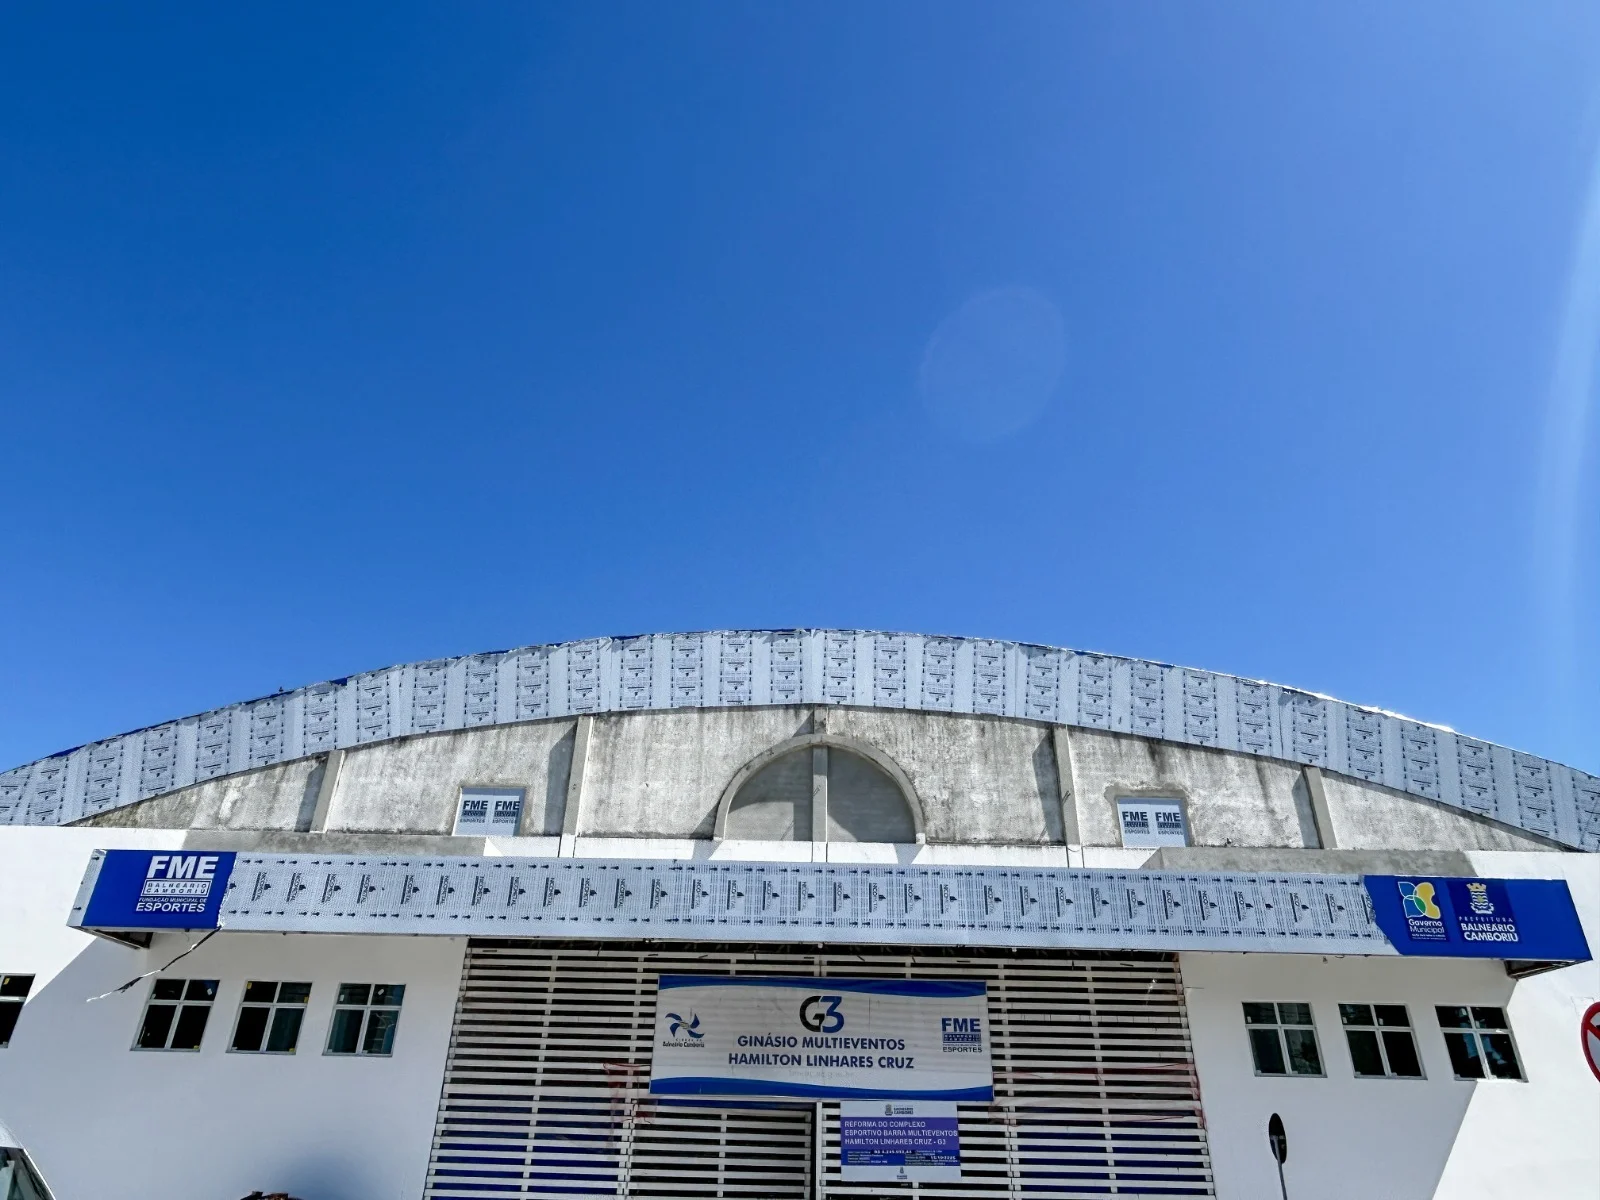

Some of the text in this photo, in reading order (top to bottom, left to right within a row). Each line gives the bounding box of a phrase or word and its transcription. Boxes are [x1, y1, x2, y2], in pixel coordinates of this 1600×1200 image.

[463, 800, 488, 810] FME
[495, 801, 521, 811] FME
[1122, 811, 1148, 821] FME
[1155, 812, 1181, 822] FME
[146, 855, 219, 879] FME
[136, 902, 206, 912] ESPORTES
[1408, 919, 1443, 927] Governo
[1461, 922, 1516, 932] BALNEÁRIO
[1409, 926, 1445, 934] Municipal
[799, 995, 845, 1033] G3
[941, 1017, 981, 1033] FME
[737, 1031, 905, 1050] GINÁSIO MULTIEVENTOS
[728, 1052, 914, 1069] HAMILTON LINHARES CRUZ
